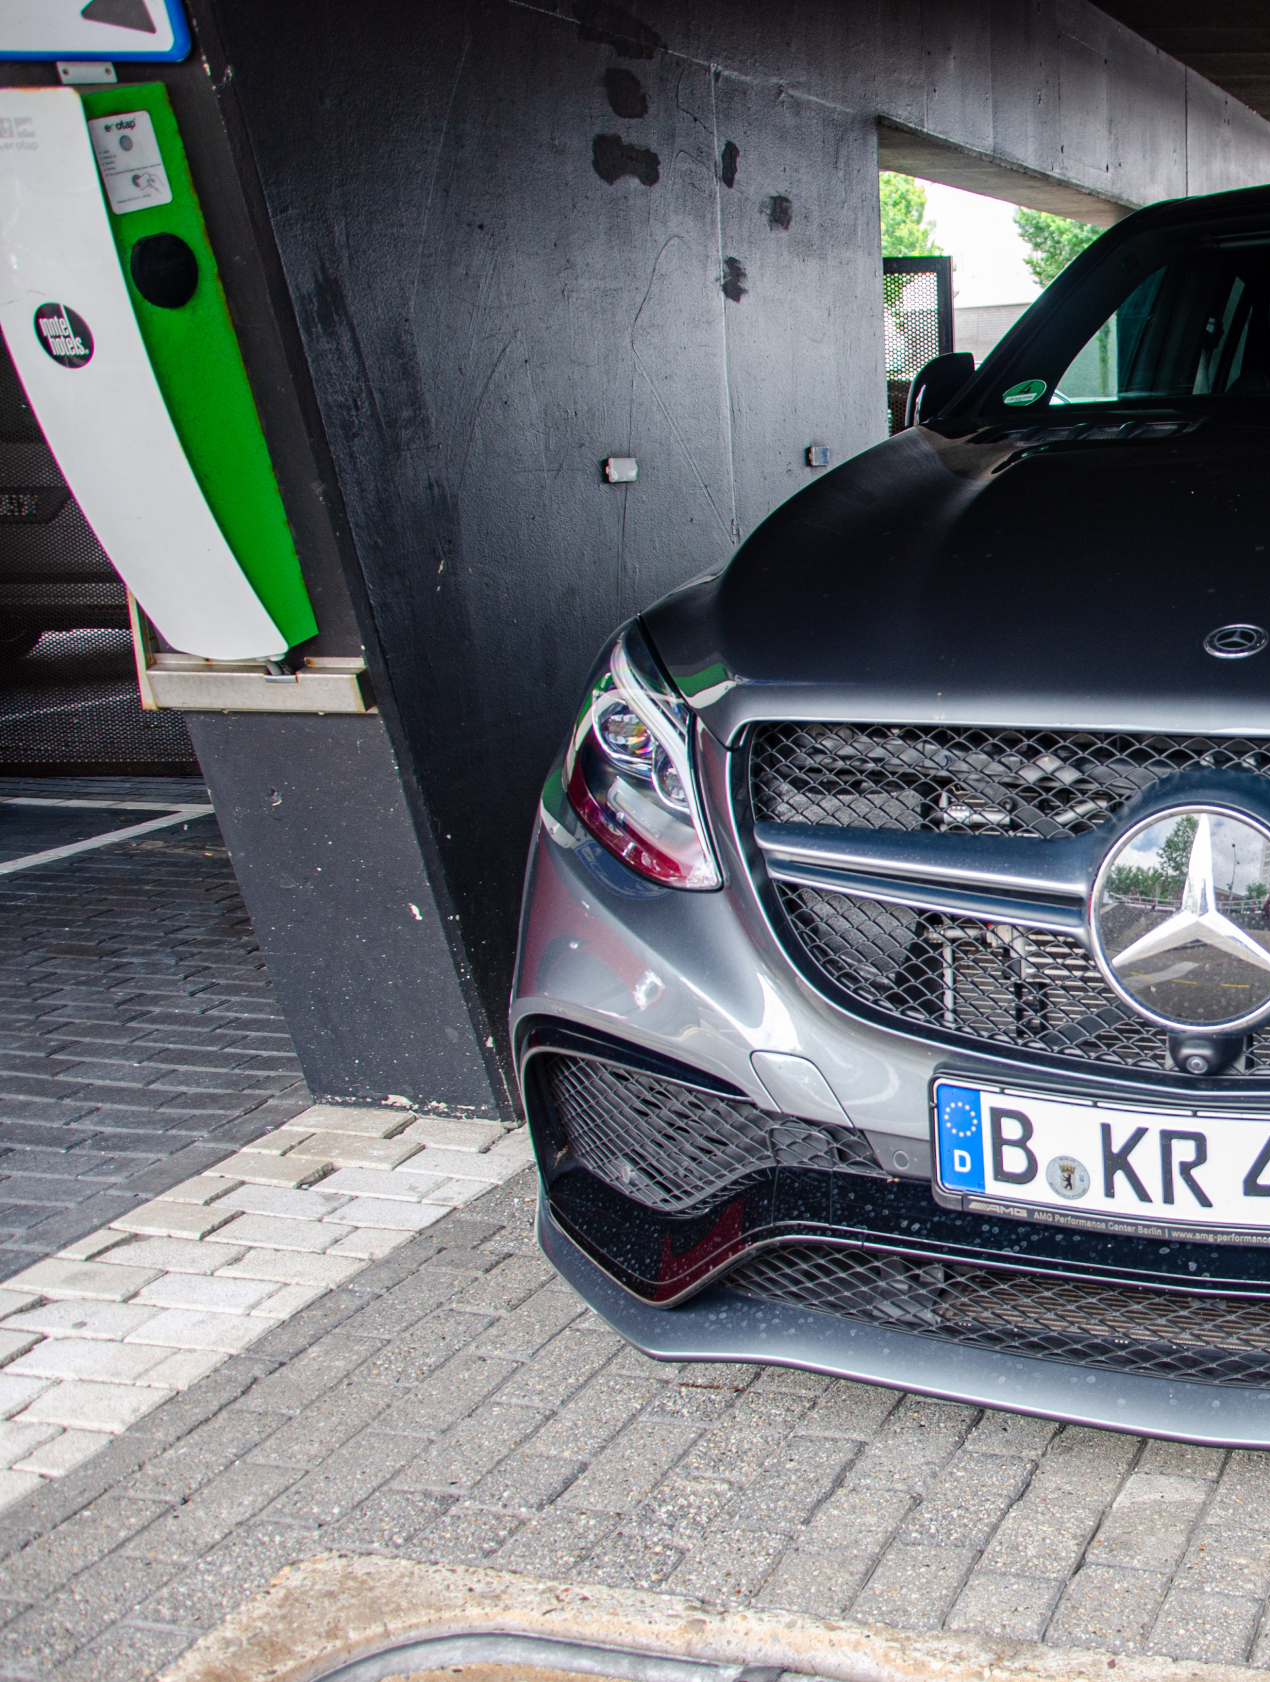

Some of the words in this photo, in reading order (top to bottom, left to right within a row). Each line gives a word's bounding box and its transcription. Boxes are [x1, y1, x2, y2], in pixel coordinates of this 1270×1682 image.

[954, 1149, 971, 1173] D
[989, 1106, 1038, 1185] B
[1100, 1122, 1213, 1208] KR
[986, 1202, 1028, 1217] AMG
[1033, 1211, 1053, 1222] AMG
[1055, 1214, 1106, 1229] Performance
[1108, 1221, 1136, 1232] Center
[1138, 1224, 1162, 1236] Berlin
